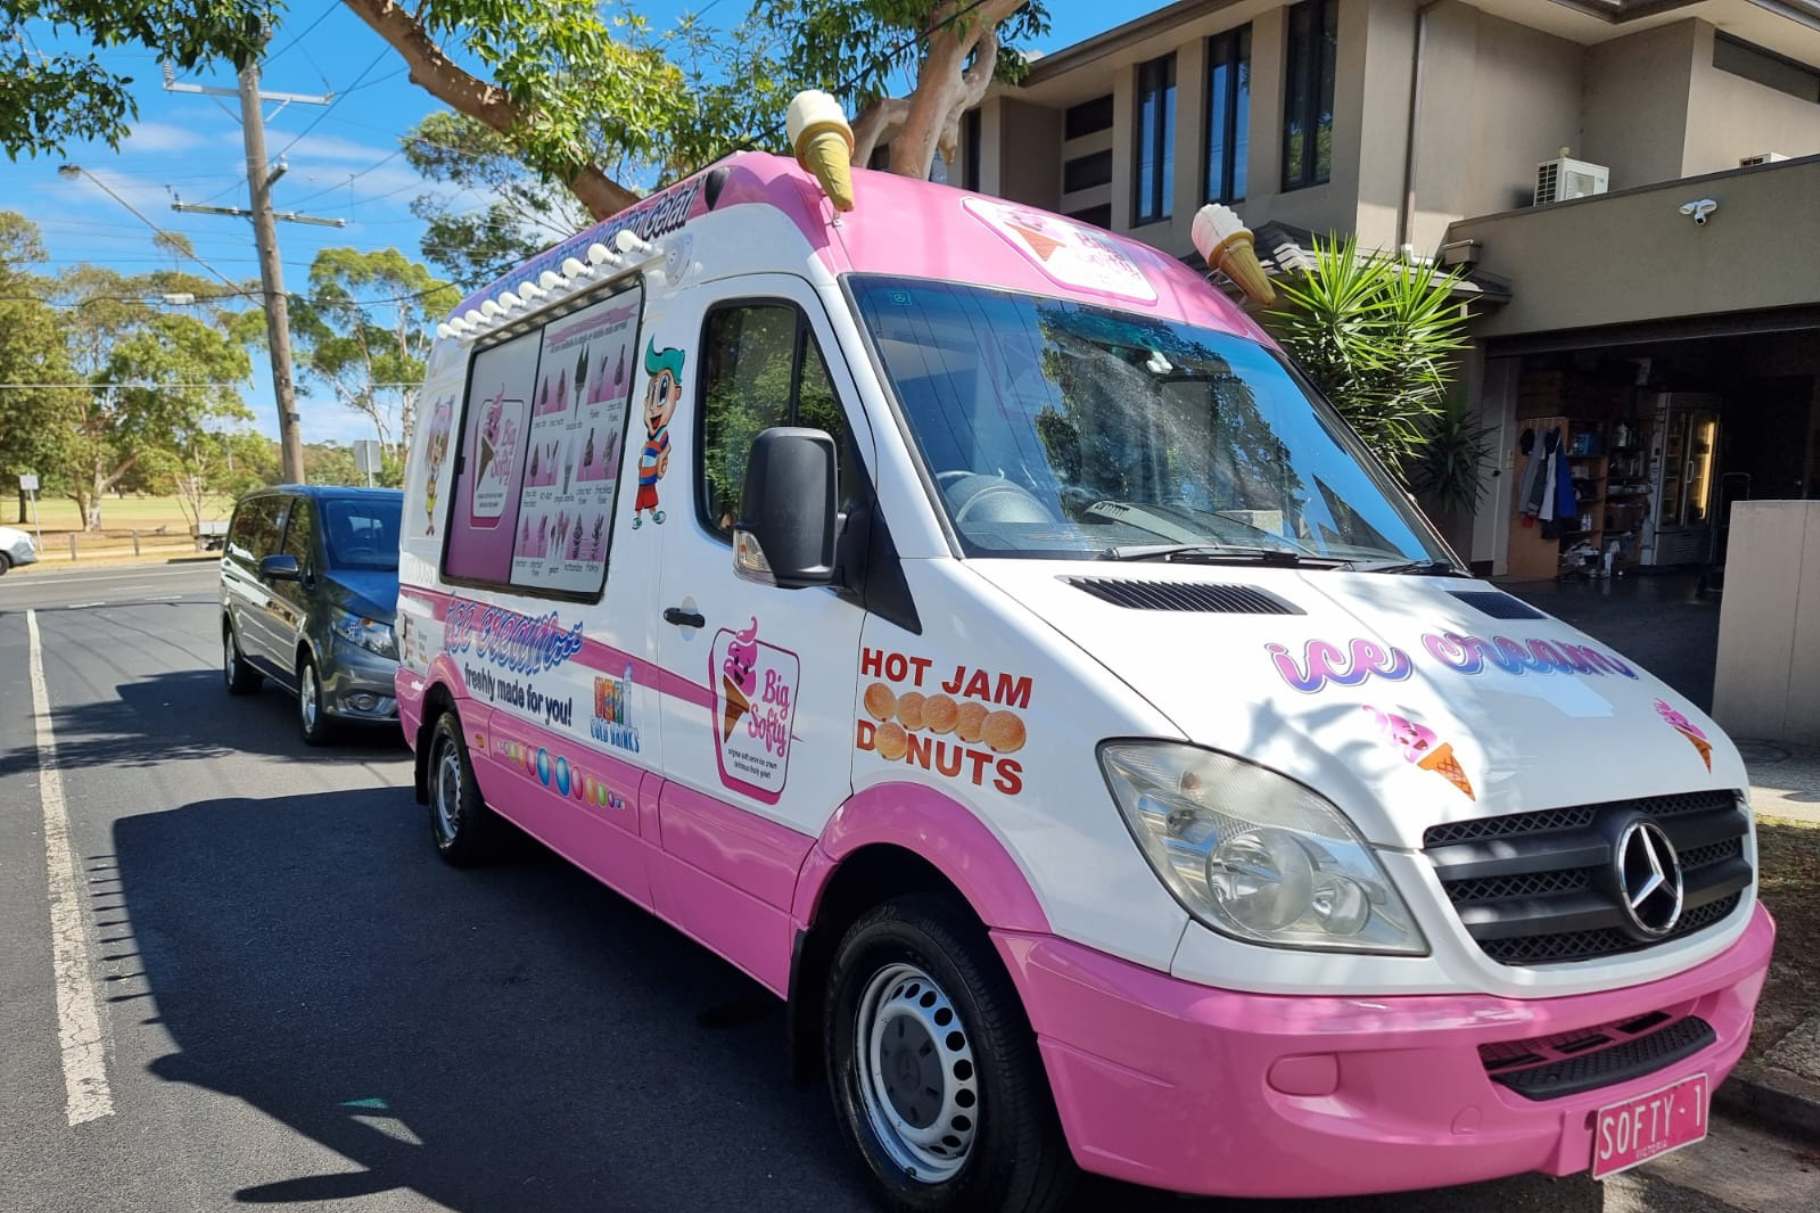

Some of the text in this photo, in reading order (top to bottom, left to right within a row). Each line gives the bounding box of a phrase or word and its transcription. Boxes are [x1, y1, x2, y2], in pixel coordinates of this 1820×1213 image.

[861, 647, 1033, 709] HOT JAM
[1264, 632, 1640, 694] ice cream
[464, 662, 573, 727] freshly made for you!
[762, 669, 790, 720] Big
[748, 704, 787, 758] Softy
